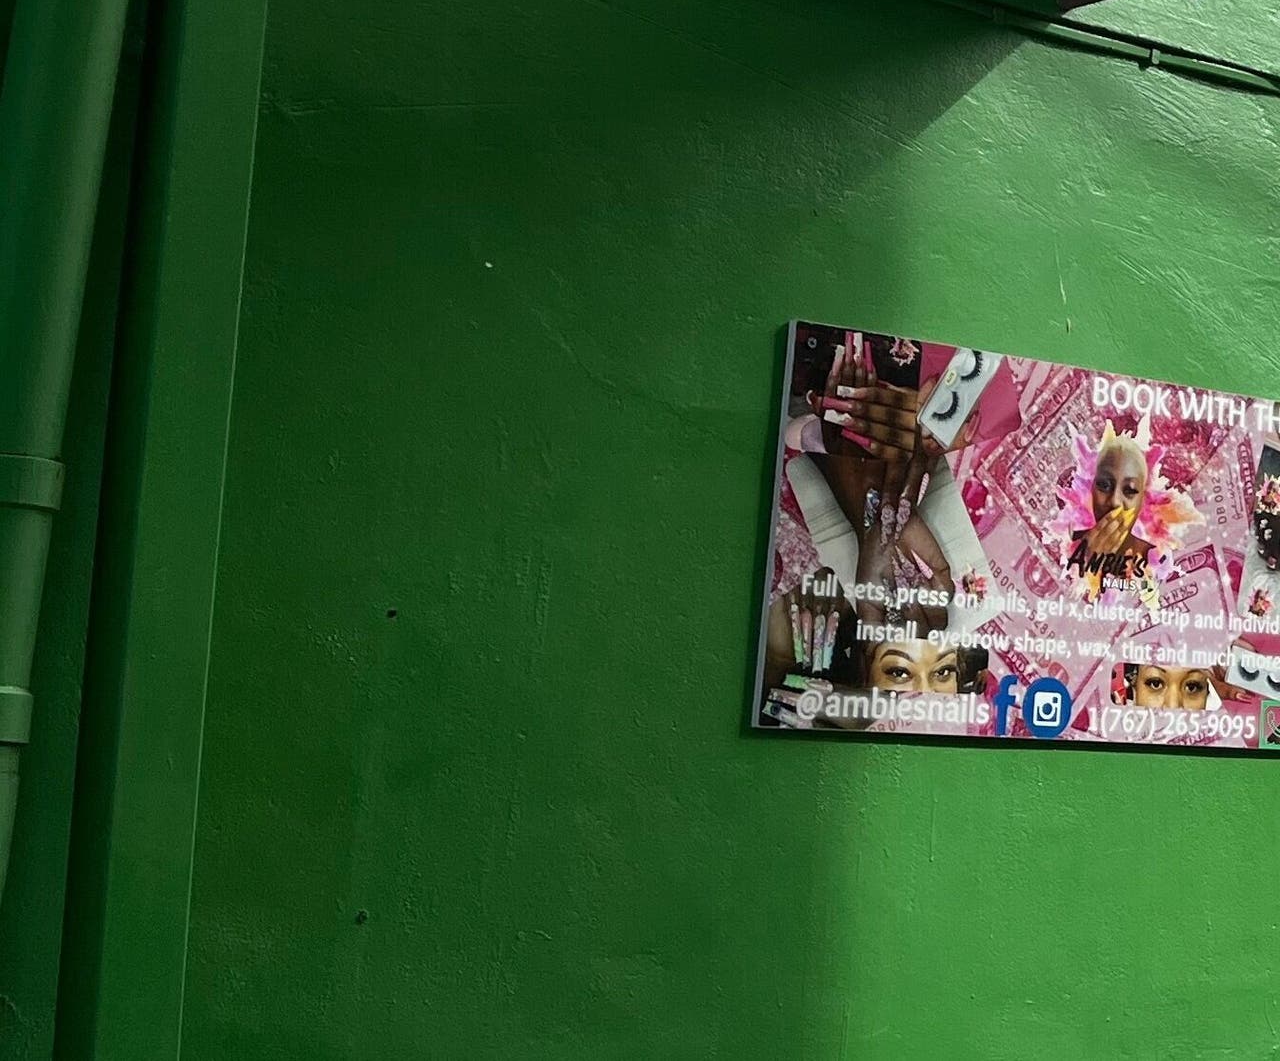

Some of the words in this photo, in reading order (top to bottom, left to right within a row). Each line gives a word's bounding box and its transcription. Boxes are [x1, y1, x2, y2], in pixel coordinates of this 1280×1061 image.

[1092, 376, 1172, 420] BOOK
[1177, 388, 1246, 430] WITH
[801, 574, 838, 598] Full
[843, 582, 891, 607] sets,
[896, 586, 948, 610] press
[953, 594, 978, 609] on
[984, 591, 1031, 616] nails,
[1036, 595, 1064, 621] gel
[1152, 606, 1191, 633] strip
[1194, 609, 1225, 630] and
[1102, 578, 1137, 591] NAILS
[927, 628, 1010, 652] eyebrow
[1014, 633, 1072, 657] shape,
[1077, 642, 1116, 662] wax,
[1122, 640, 1152, 660] tint
[1155, 644, 1188, 665] and
[1192, 648, 1236, 669] much
[796, 686, 990, 724] @ambiesnails
[1088, 707, 1156, 738] 1(767)
[1163, 709, 1257, 739] 265-9095
